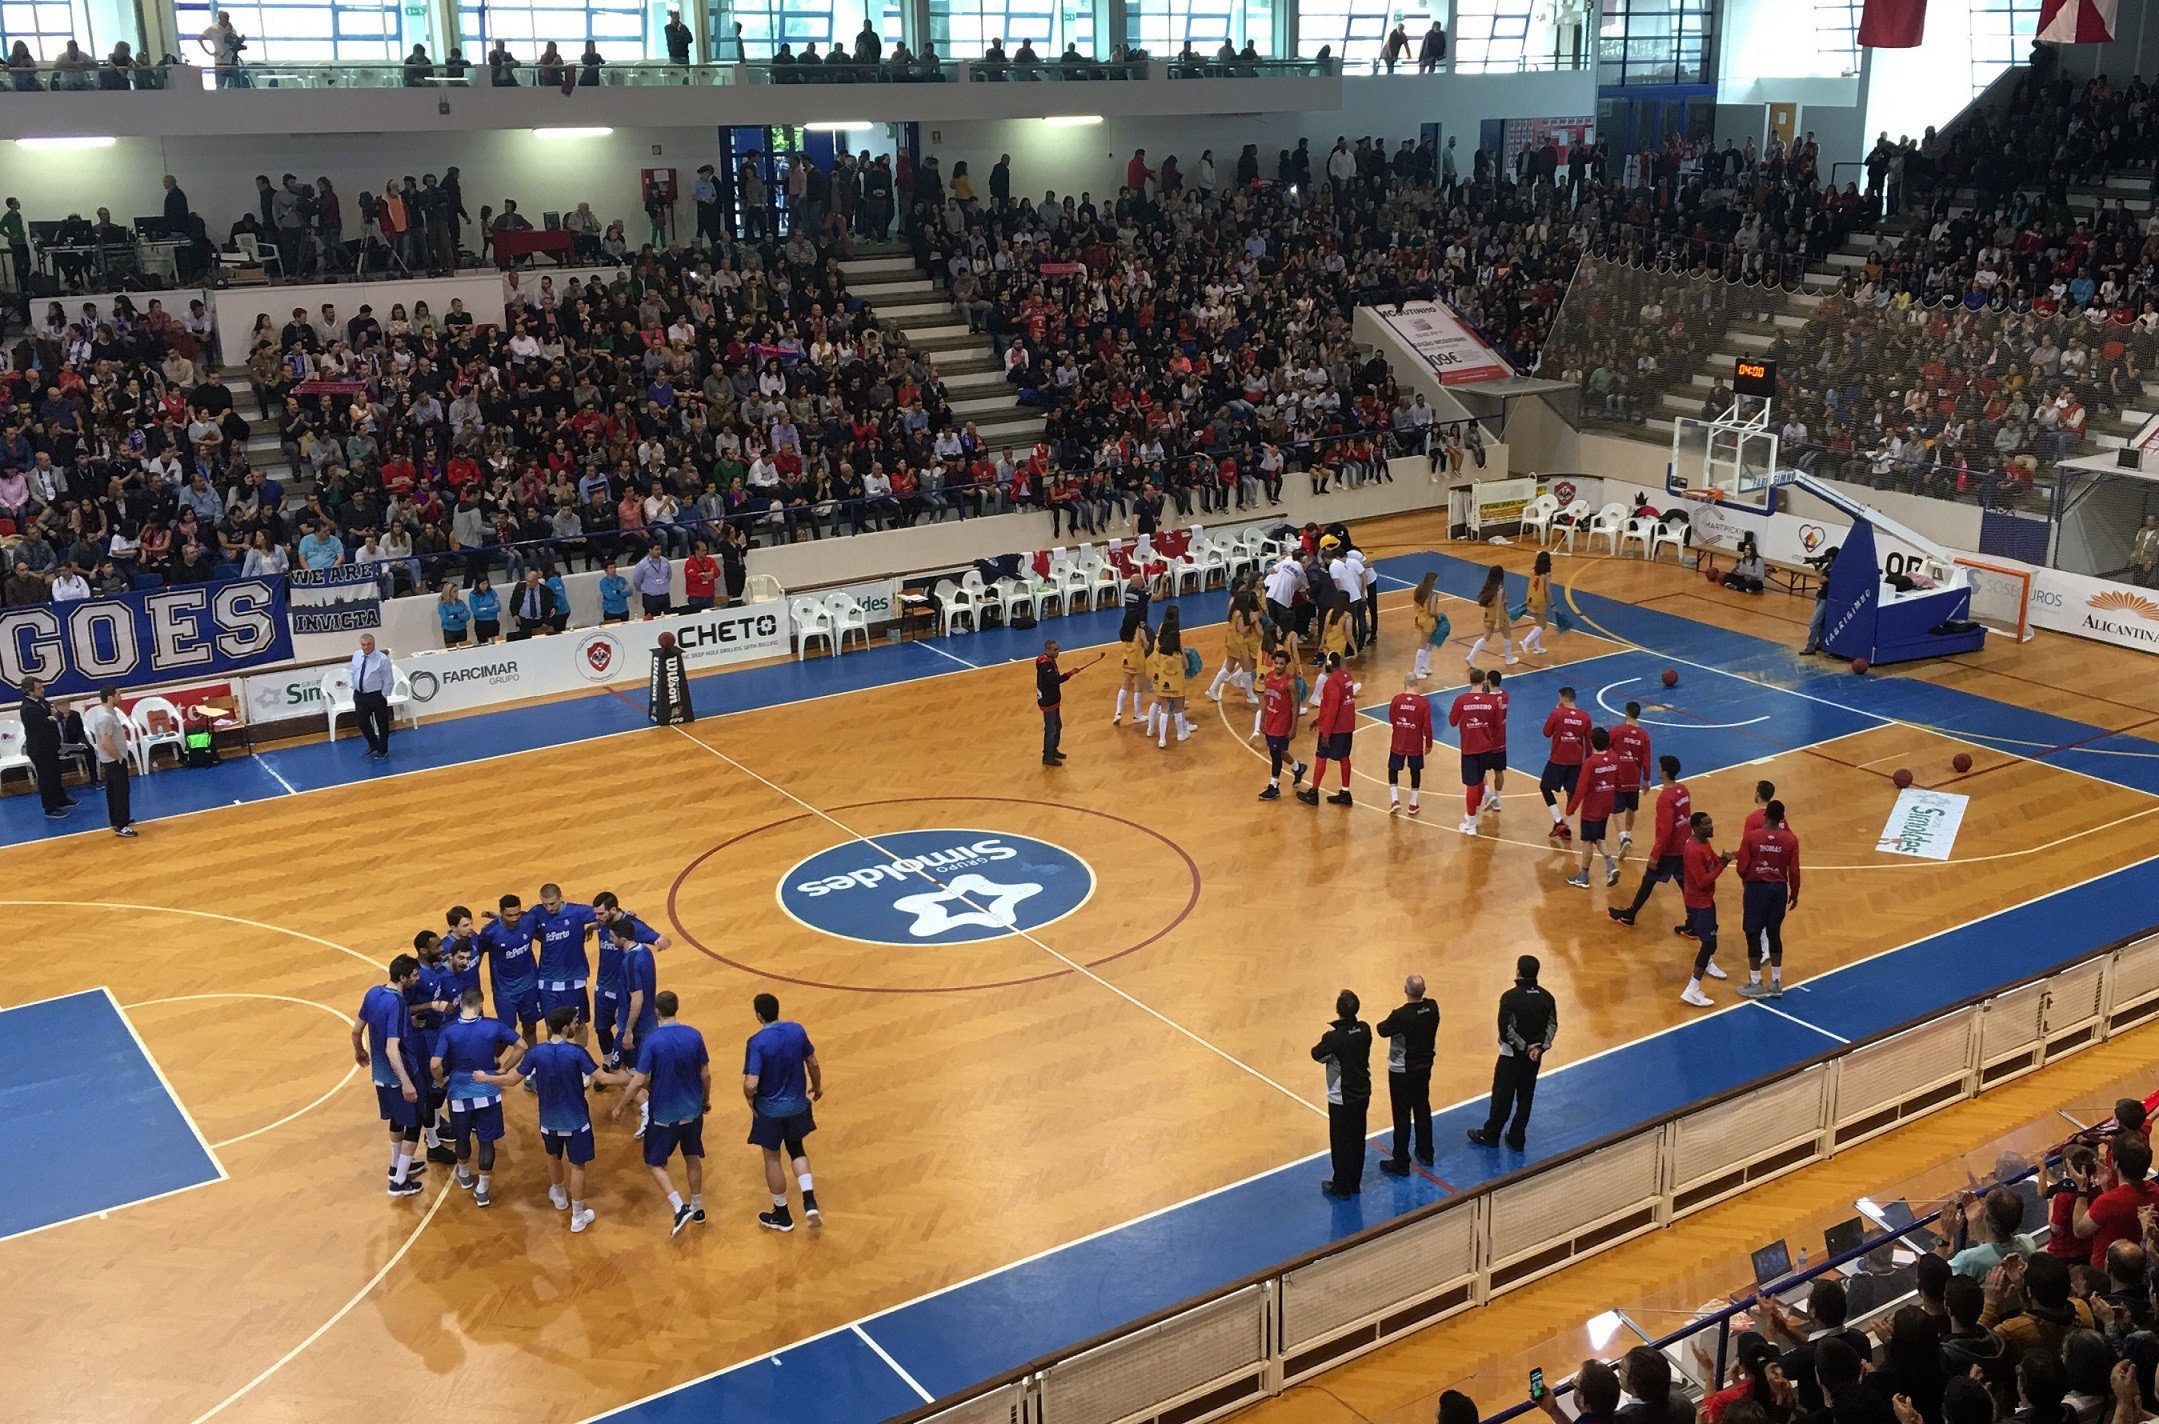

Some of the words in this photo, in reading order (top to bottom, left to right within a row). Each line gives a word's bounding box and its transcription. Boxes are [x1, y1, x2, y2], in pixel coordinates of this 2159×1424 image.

[1739, 364, 1764, 378] 04:00
[291, 568, 325, 586] WE
[328, 561, 374, 584] ARE
[296, 608, 380, 632] INVICTA
[677, 614, 777, 649] CHETO
[0, 580, 276, 689] GOES
[443, 661, 518, 685] FARCIMAR
[489, 673, 520, 686] GRUPO
[665, 656, 680, 705] Wilson
[1894, 805, 1946, 854] Simoldes
[797, 839, 1017, 897] Simoldes
[936, 857, 988, 873] GRUPO
